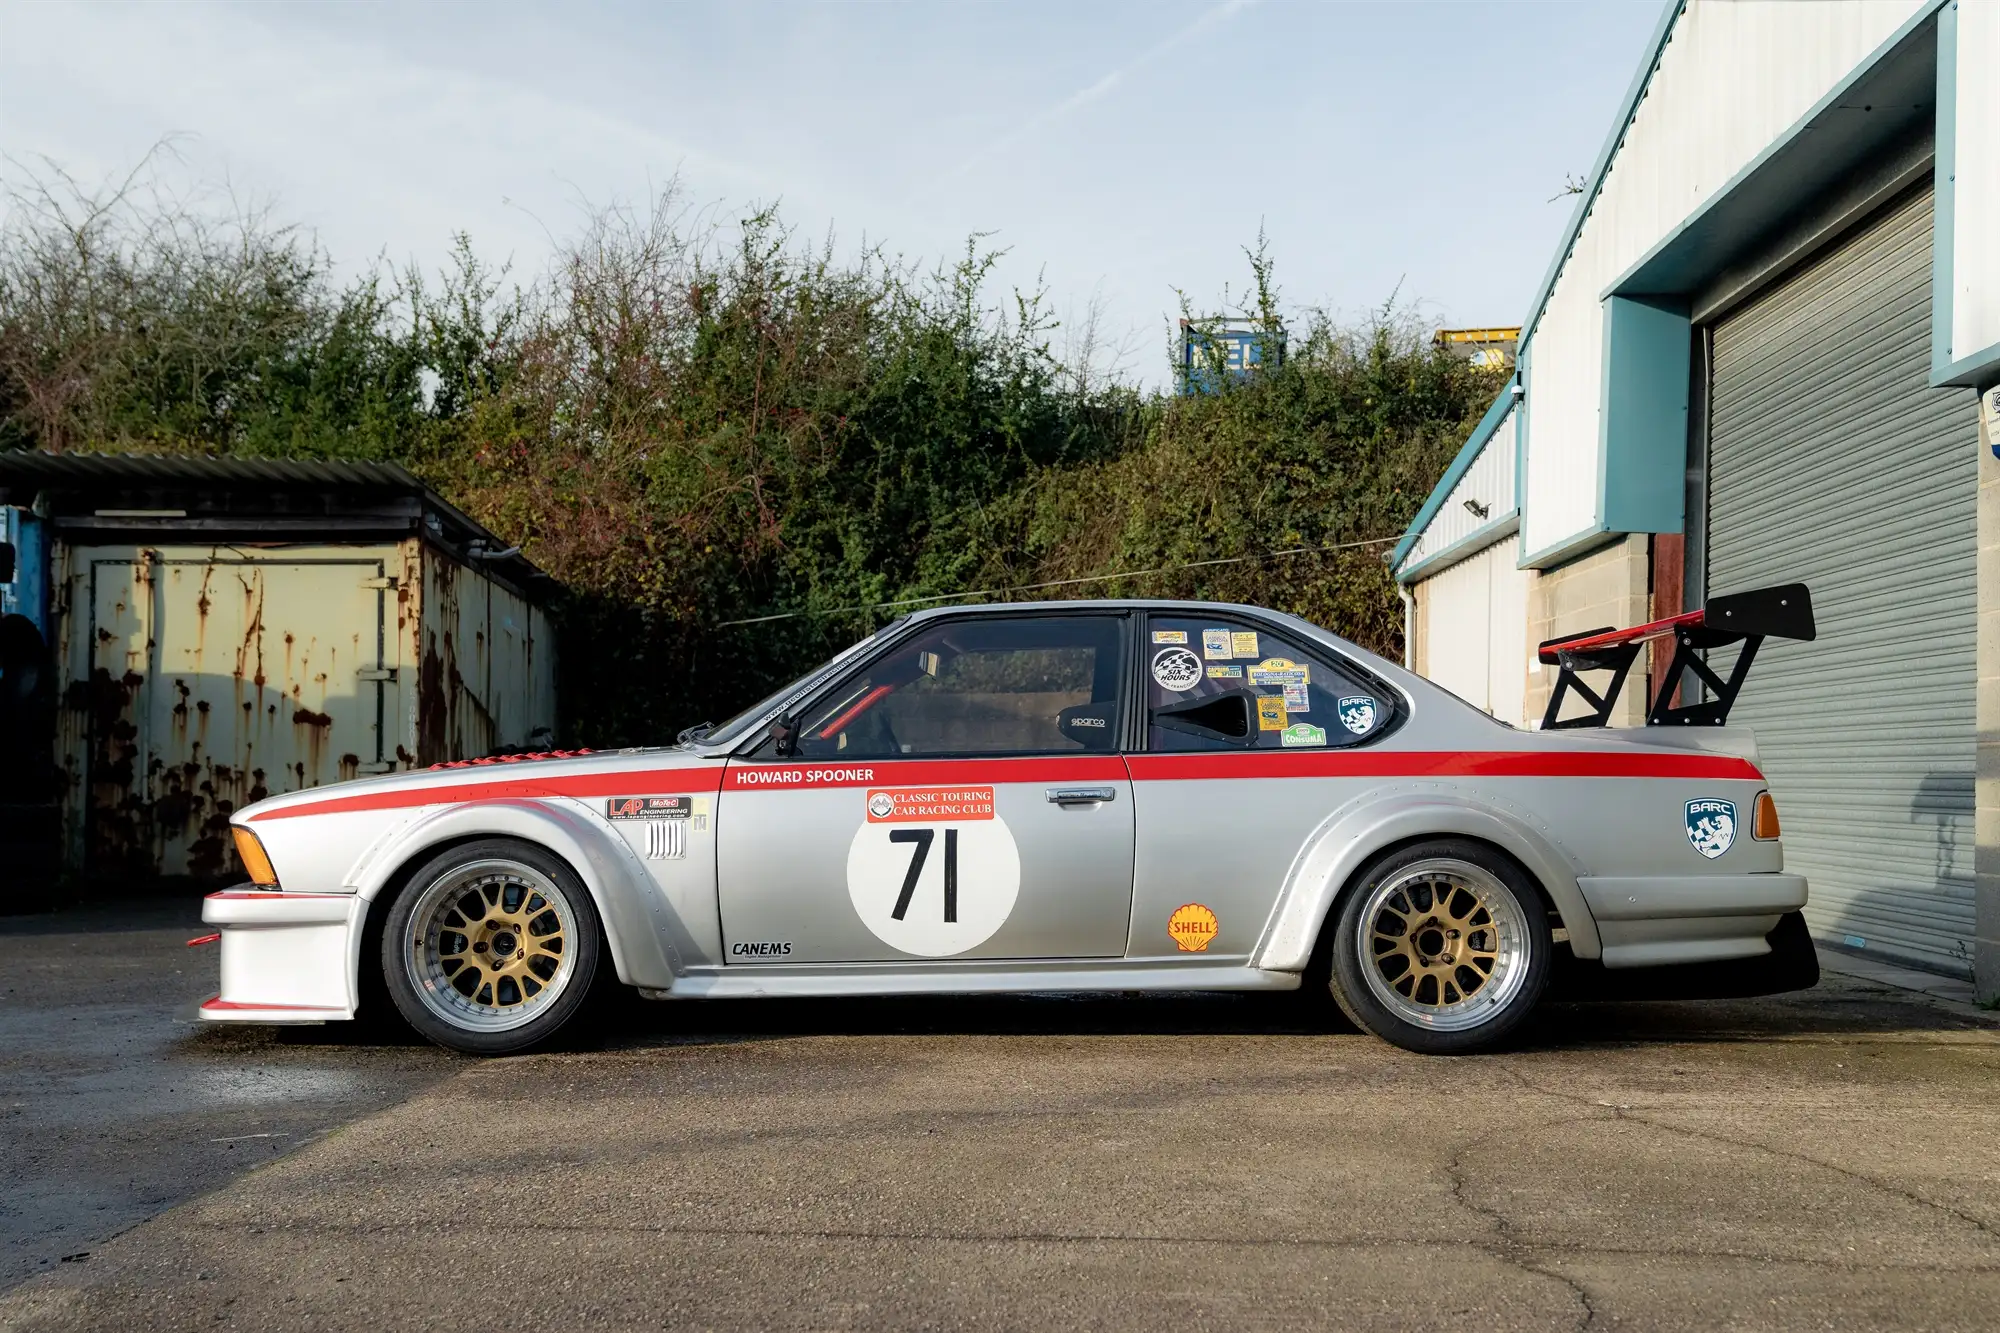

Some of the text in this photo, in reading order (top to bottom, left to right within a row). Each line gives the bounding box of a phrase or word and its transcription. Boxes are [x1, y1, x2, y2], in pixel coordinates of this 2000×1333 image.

[1160, 673, 1191, 681] HOURS
[1341, 697, 1372, 706] BARC
[1071, 718, 1105, 727] sparco
[1285, 733, 1323, 743] CONSUMA
[737, 769, 874, 784] HOWARD SPOONER
[651, 799, 677, 807] MoTeC
[893, 792, 939, 803] CLASSIC
[941, 791, 991, 802] TOURING
[609, 799, 644, 816] LAP
[893, 804, 992, 816] CAR RACING CLUB
[1690, 802, 1731, 814] BARC
[889, 828, 958, 923] 71
[1174, 921, 1212, 934] SHELL
[732, 942, 792, 955] CANEMS
